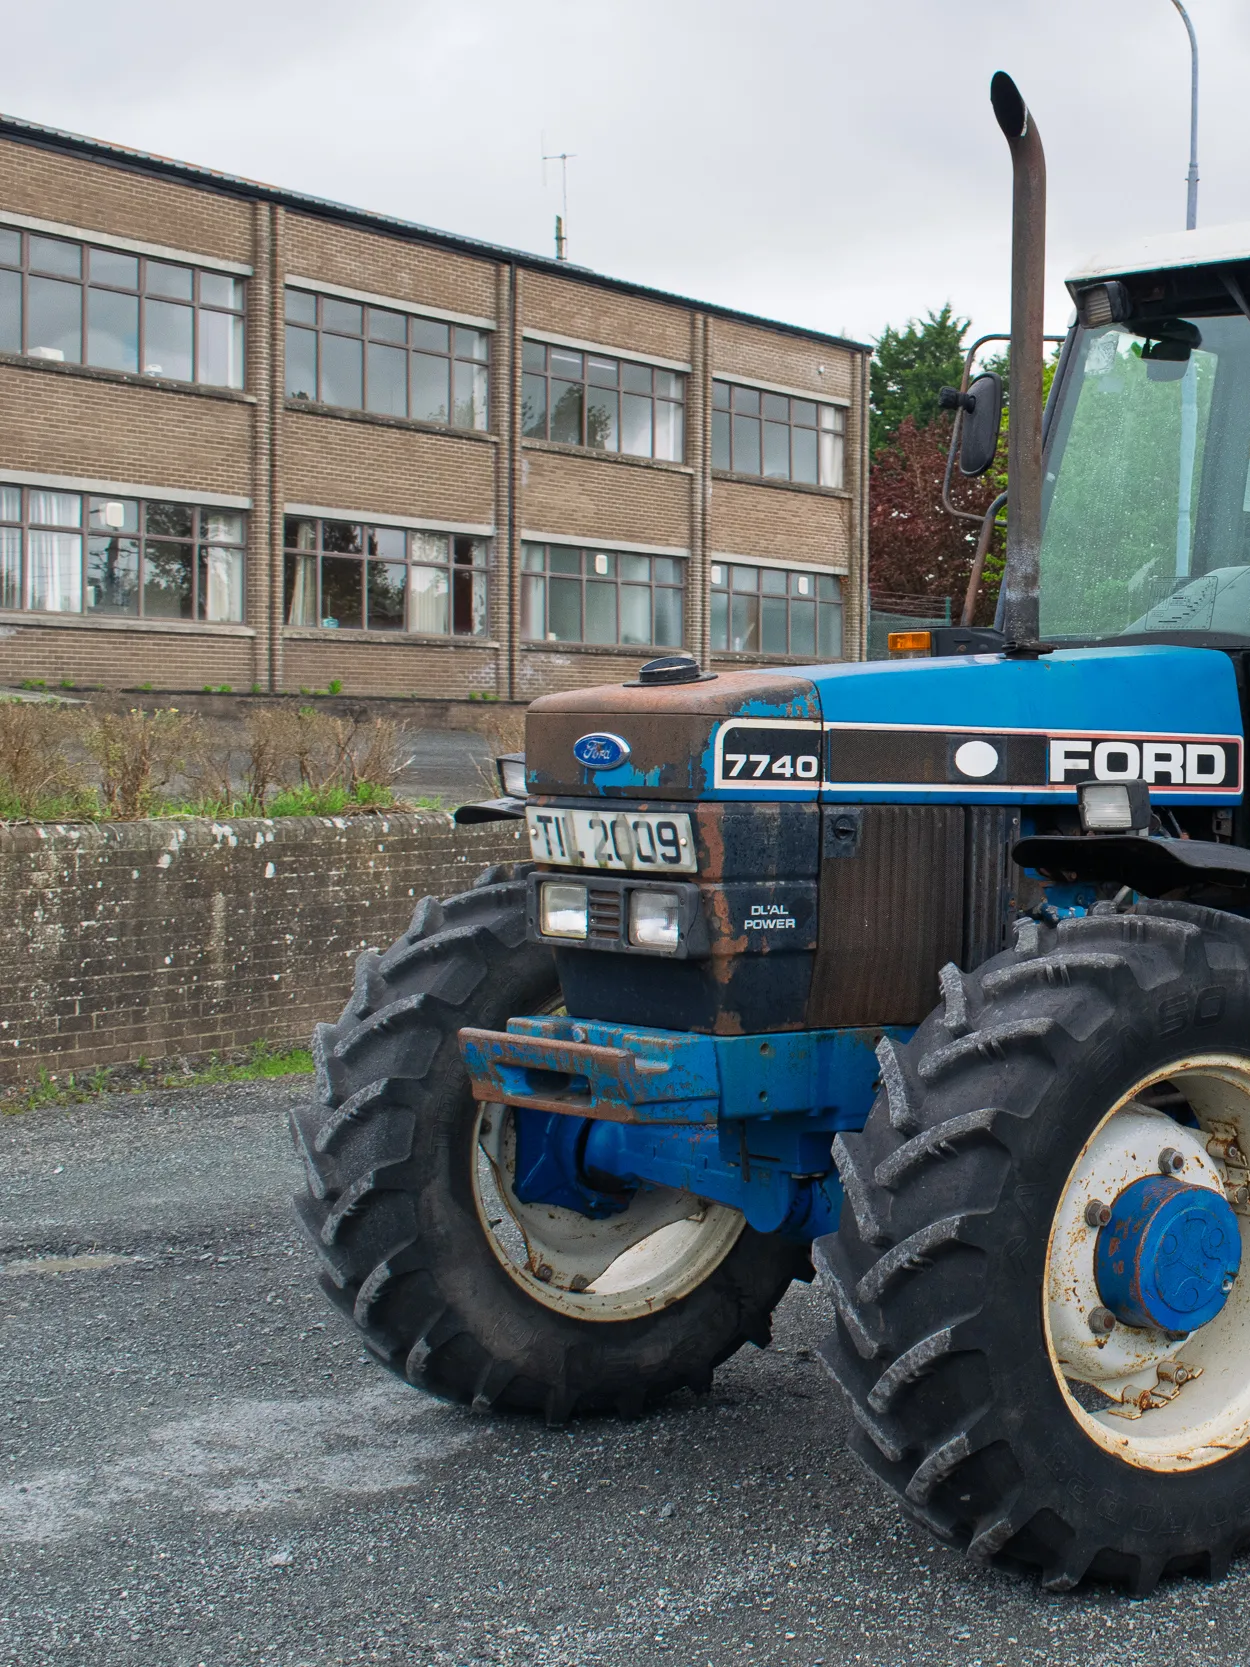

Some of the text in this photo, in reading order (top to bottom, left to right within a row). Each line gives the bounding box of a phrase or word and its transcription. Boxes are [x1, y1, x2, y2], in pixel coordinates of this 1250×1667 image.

[582, 739, 613, 760] Ford
[725, 754, 818, 778] 7740
[1050, 740, 1226, 785] FORD
[743, 918, 796, 931] POWER
